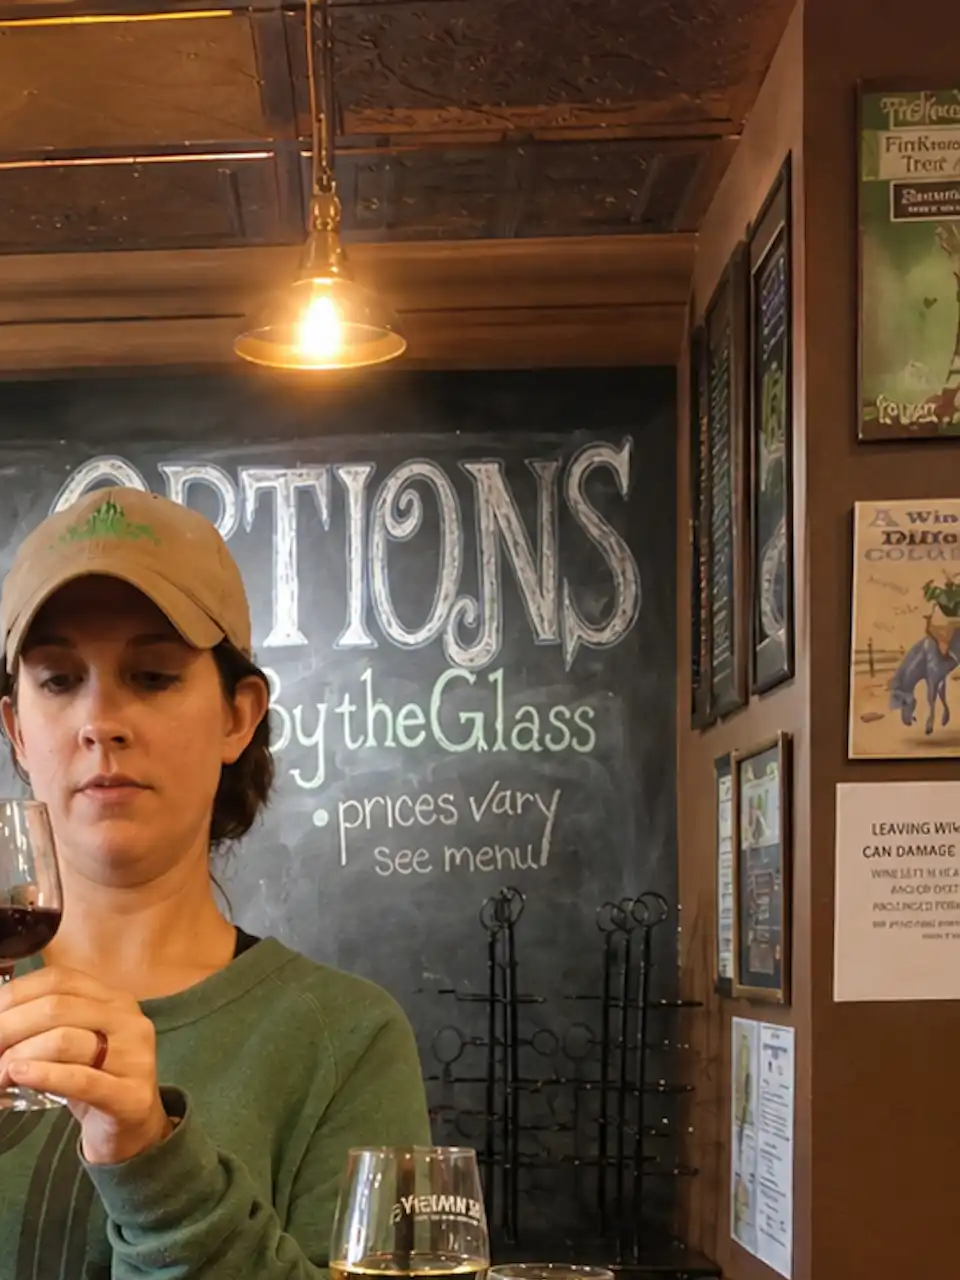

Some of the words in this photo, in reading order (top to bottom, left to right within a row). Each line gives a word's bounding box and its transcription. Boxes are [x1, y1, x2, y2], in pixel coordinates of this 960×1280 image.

[48, 436, 639, 672] PTIONS
[334, 667, 426, 750] the
[430, 667, 596, 753] Glass
[338, 790, 458, 866] prices
[468, 780, 561, 867] vary
[862, 846, 892, 858] CAN
[896, 844, 956, 858] DAMAGE
[871, 822, 931, 836] LEAVING
[374, 846, 433, 876] see
[444, 844, 539, 872] menu
